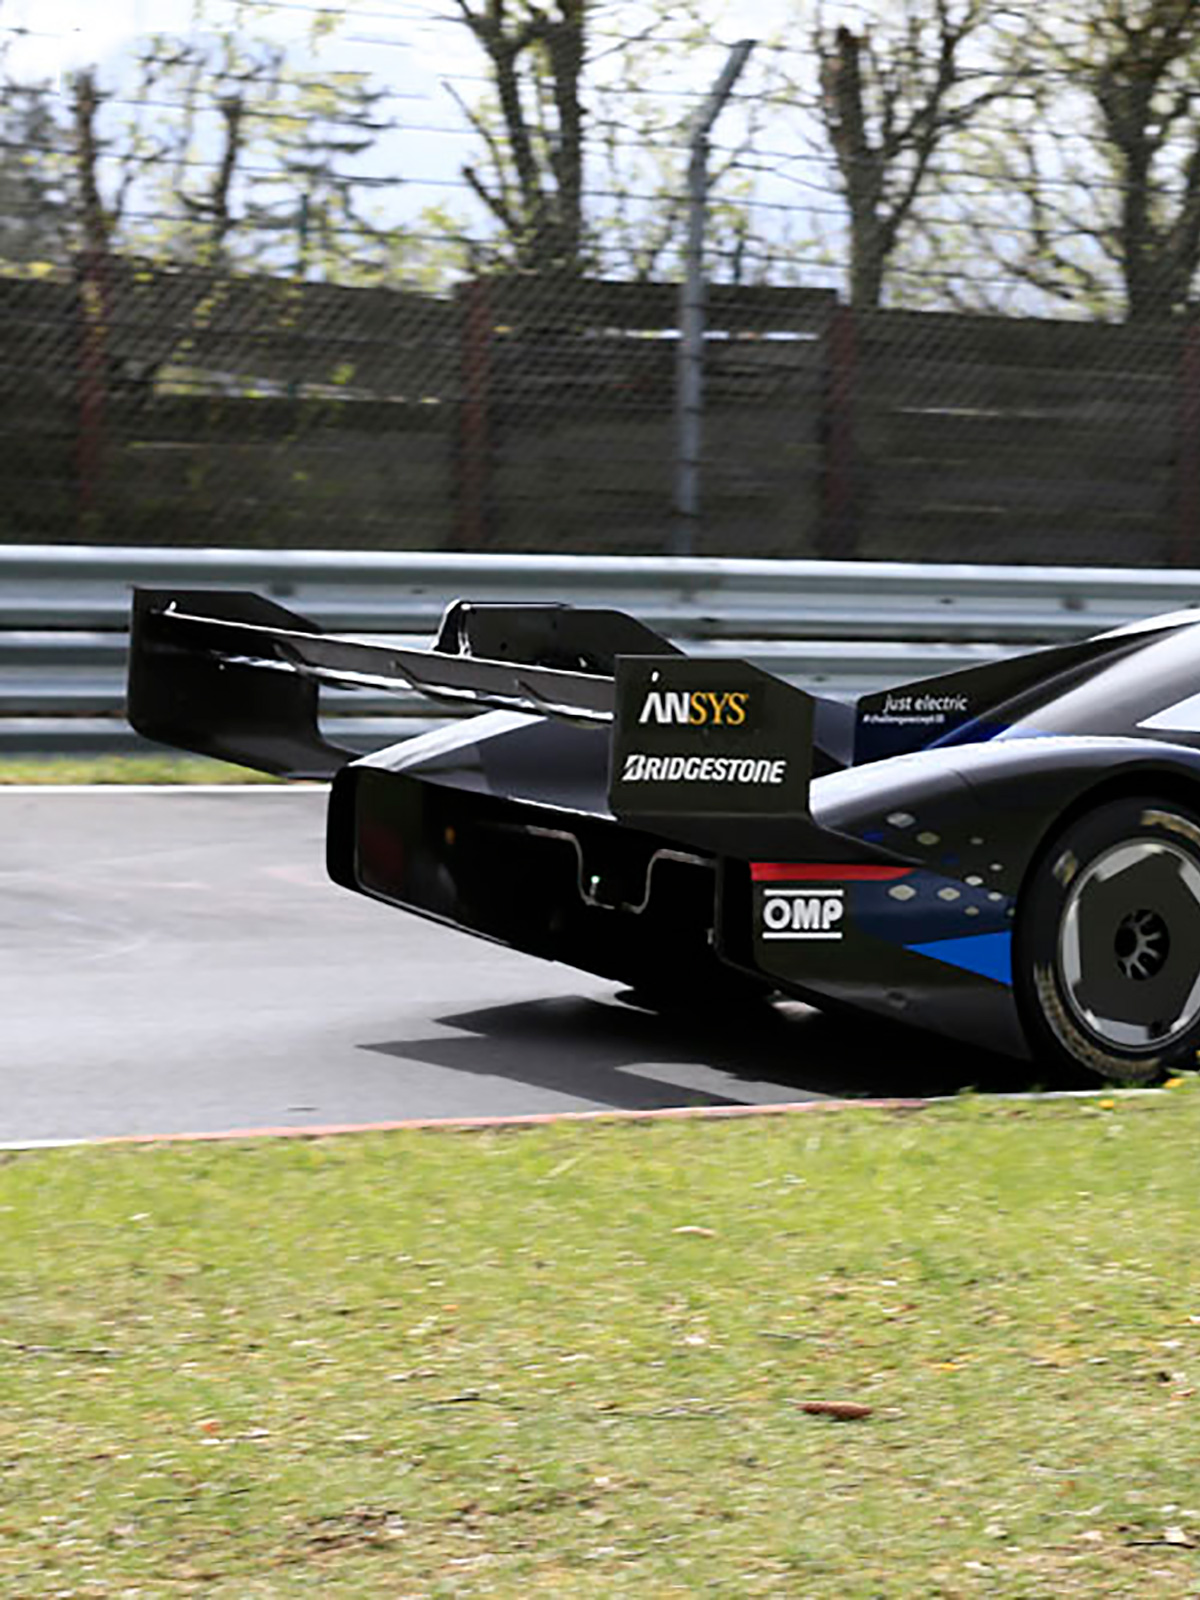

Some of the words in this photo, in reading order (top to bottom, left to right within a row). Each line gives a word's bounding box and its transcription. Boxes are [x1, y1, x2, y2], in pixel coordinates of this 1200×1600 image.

[639, 692, 748, 725] ANSYS
[883, 694, 912, 714] just
[914, 694, 968, 711] electric
[622, 754, 786, 784] BRIDGESTONE
[763, 898, 843, 930] OMP
